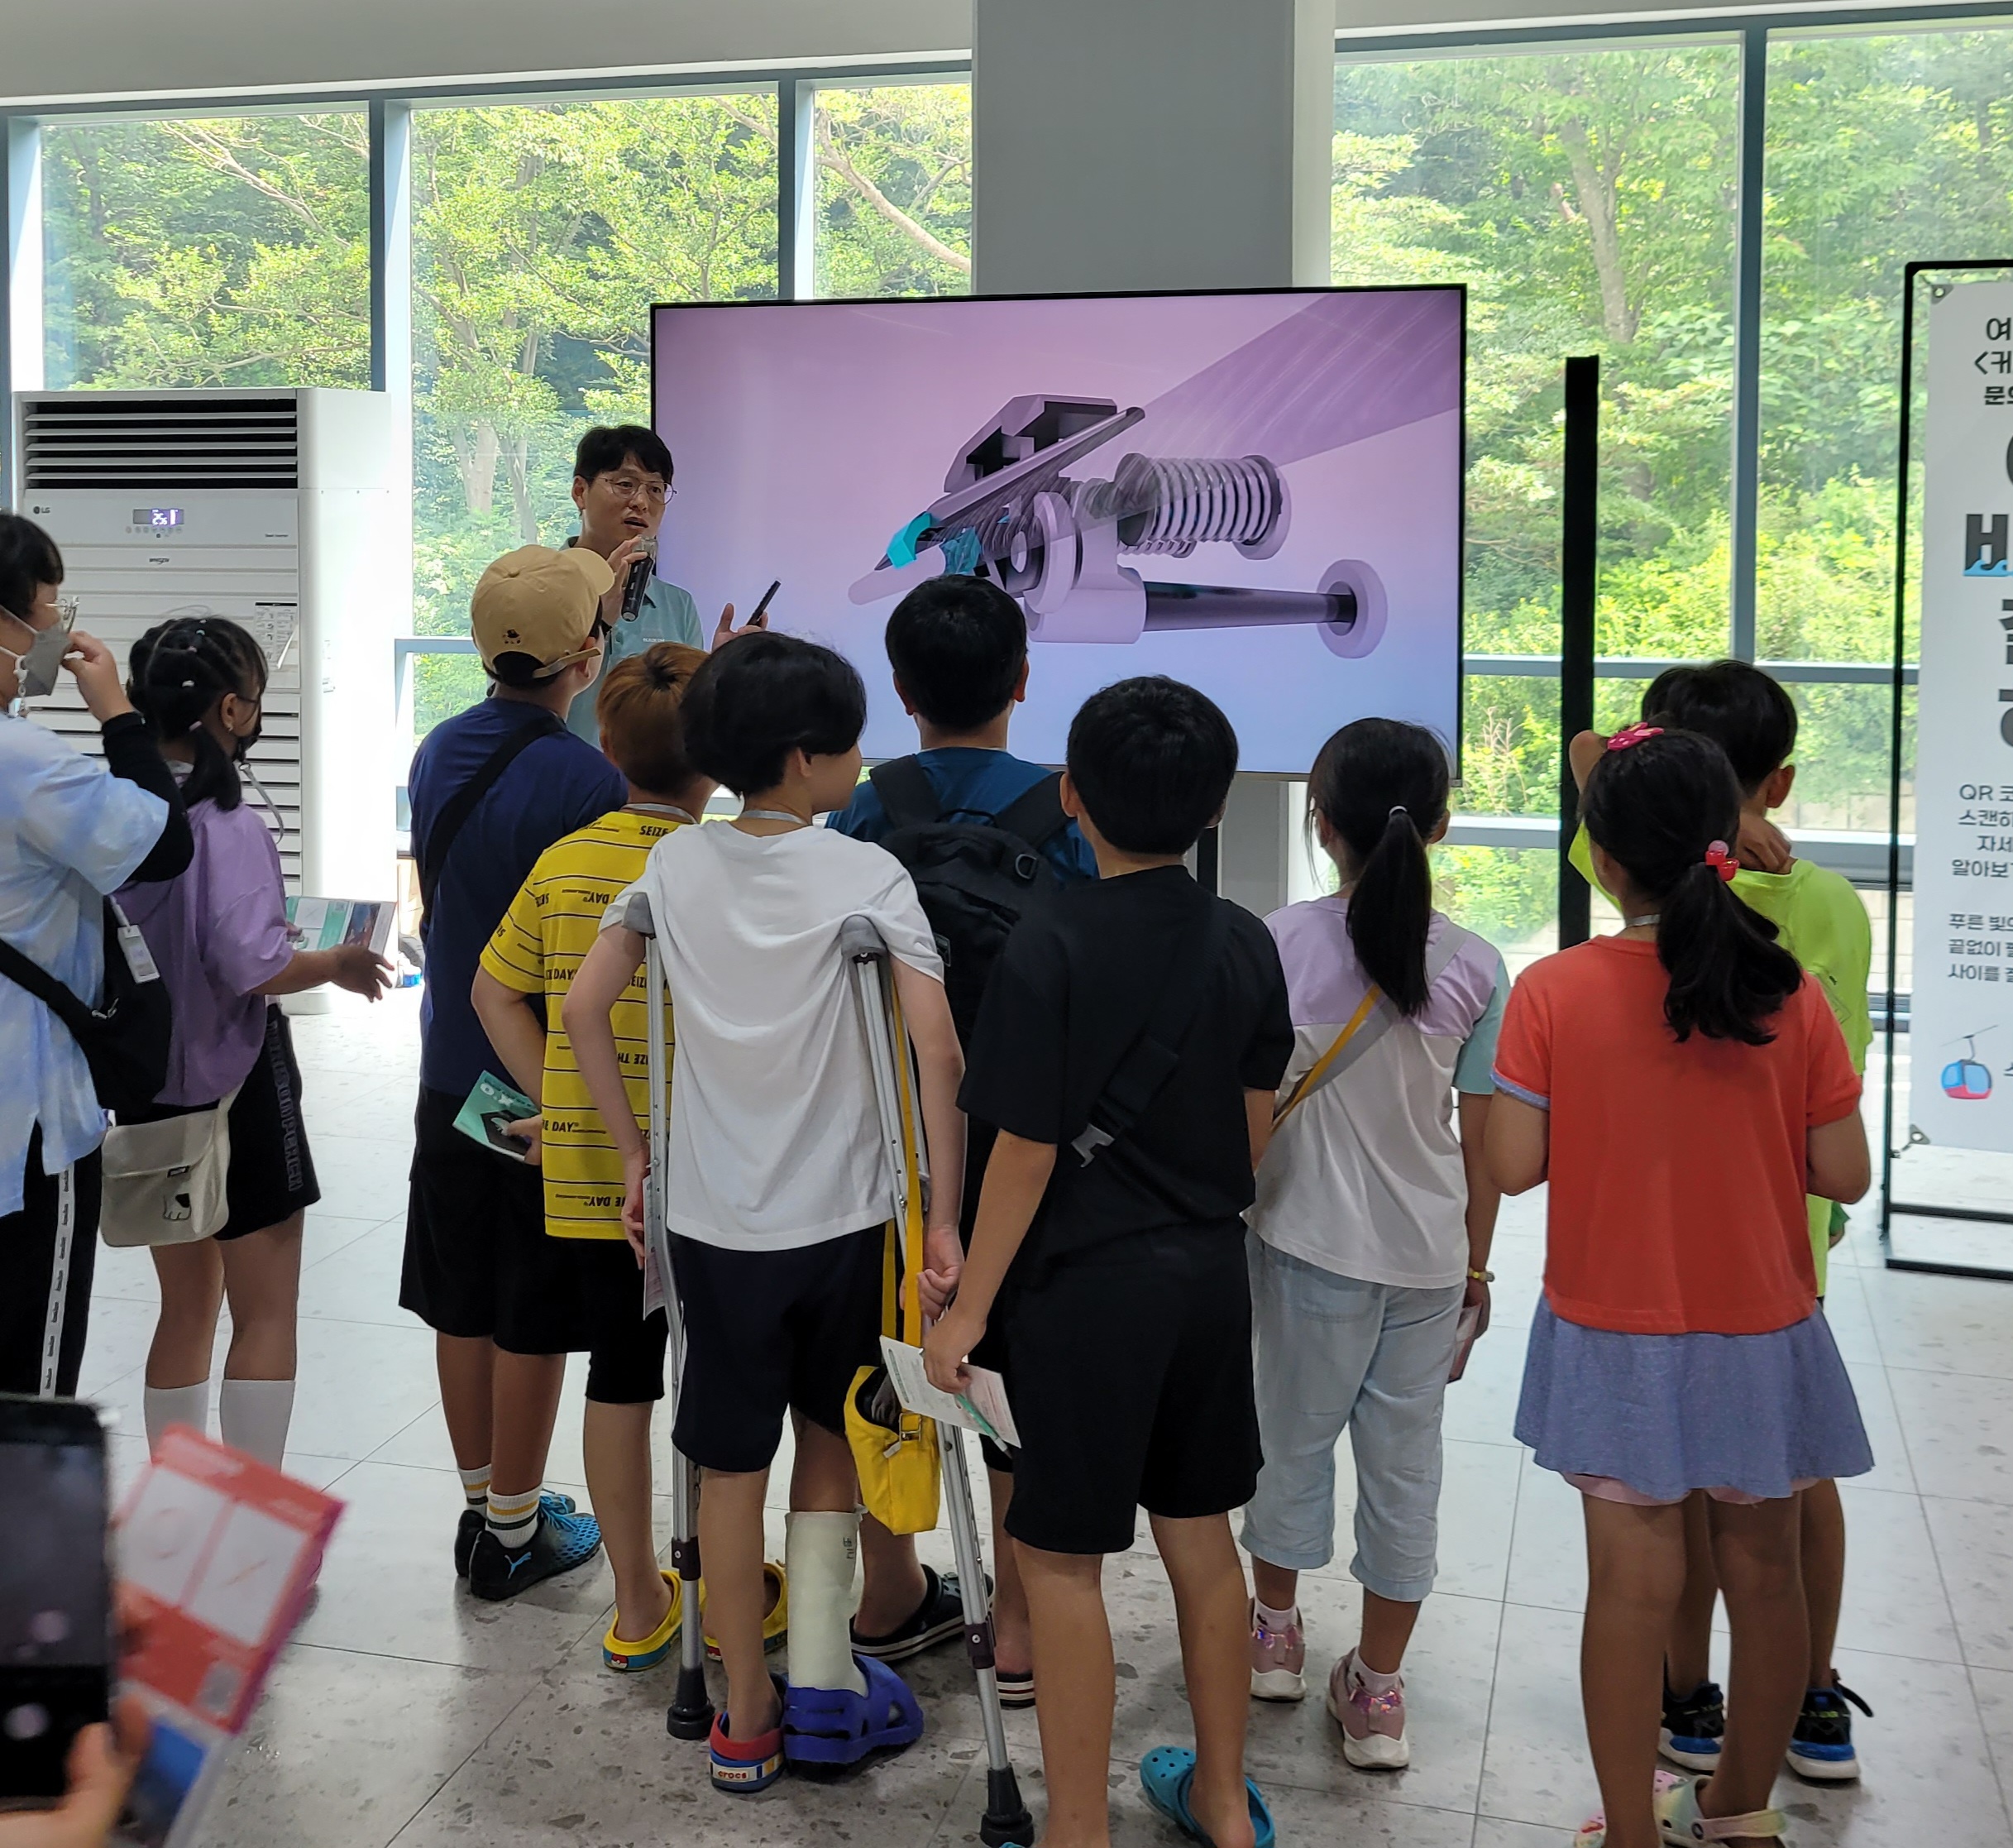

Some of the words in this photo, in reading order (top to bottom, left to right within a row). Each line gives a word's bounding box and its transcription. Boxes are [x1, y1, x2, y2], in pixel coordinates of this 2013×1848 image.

[1959, 783, 1993, 801] QR
[638, 825, 669, 837] SEIZE
[1952, 859, 2013, 879] 알아보
[1948, 913, 1984, 931] 푸른
[1948, 964, 2000, 982] 사이를
[717, 1770, 747, 1779] crocs
